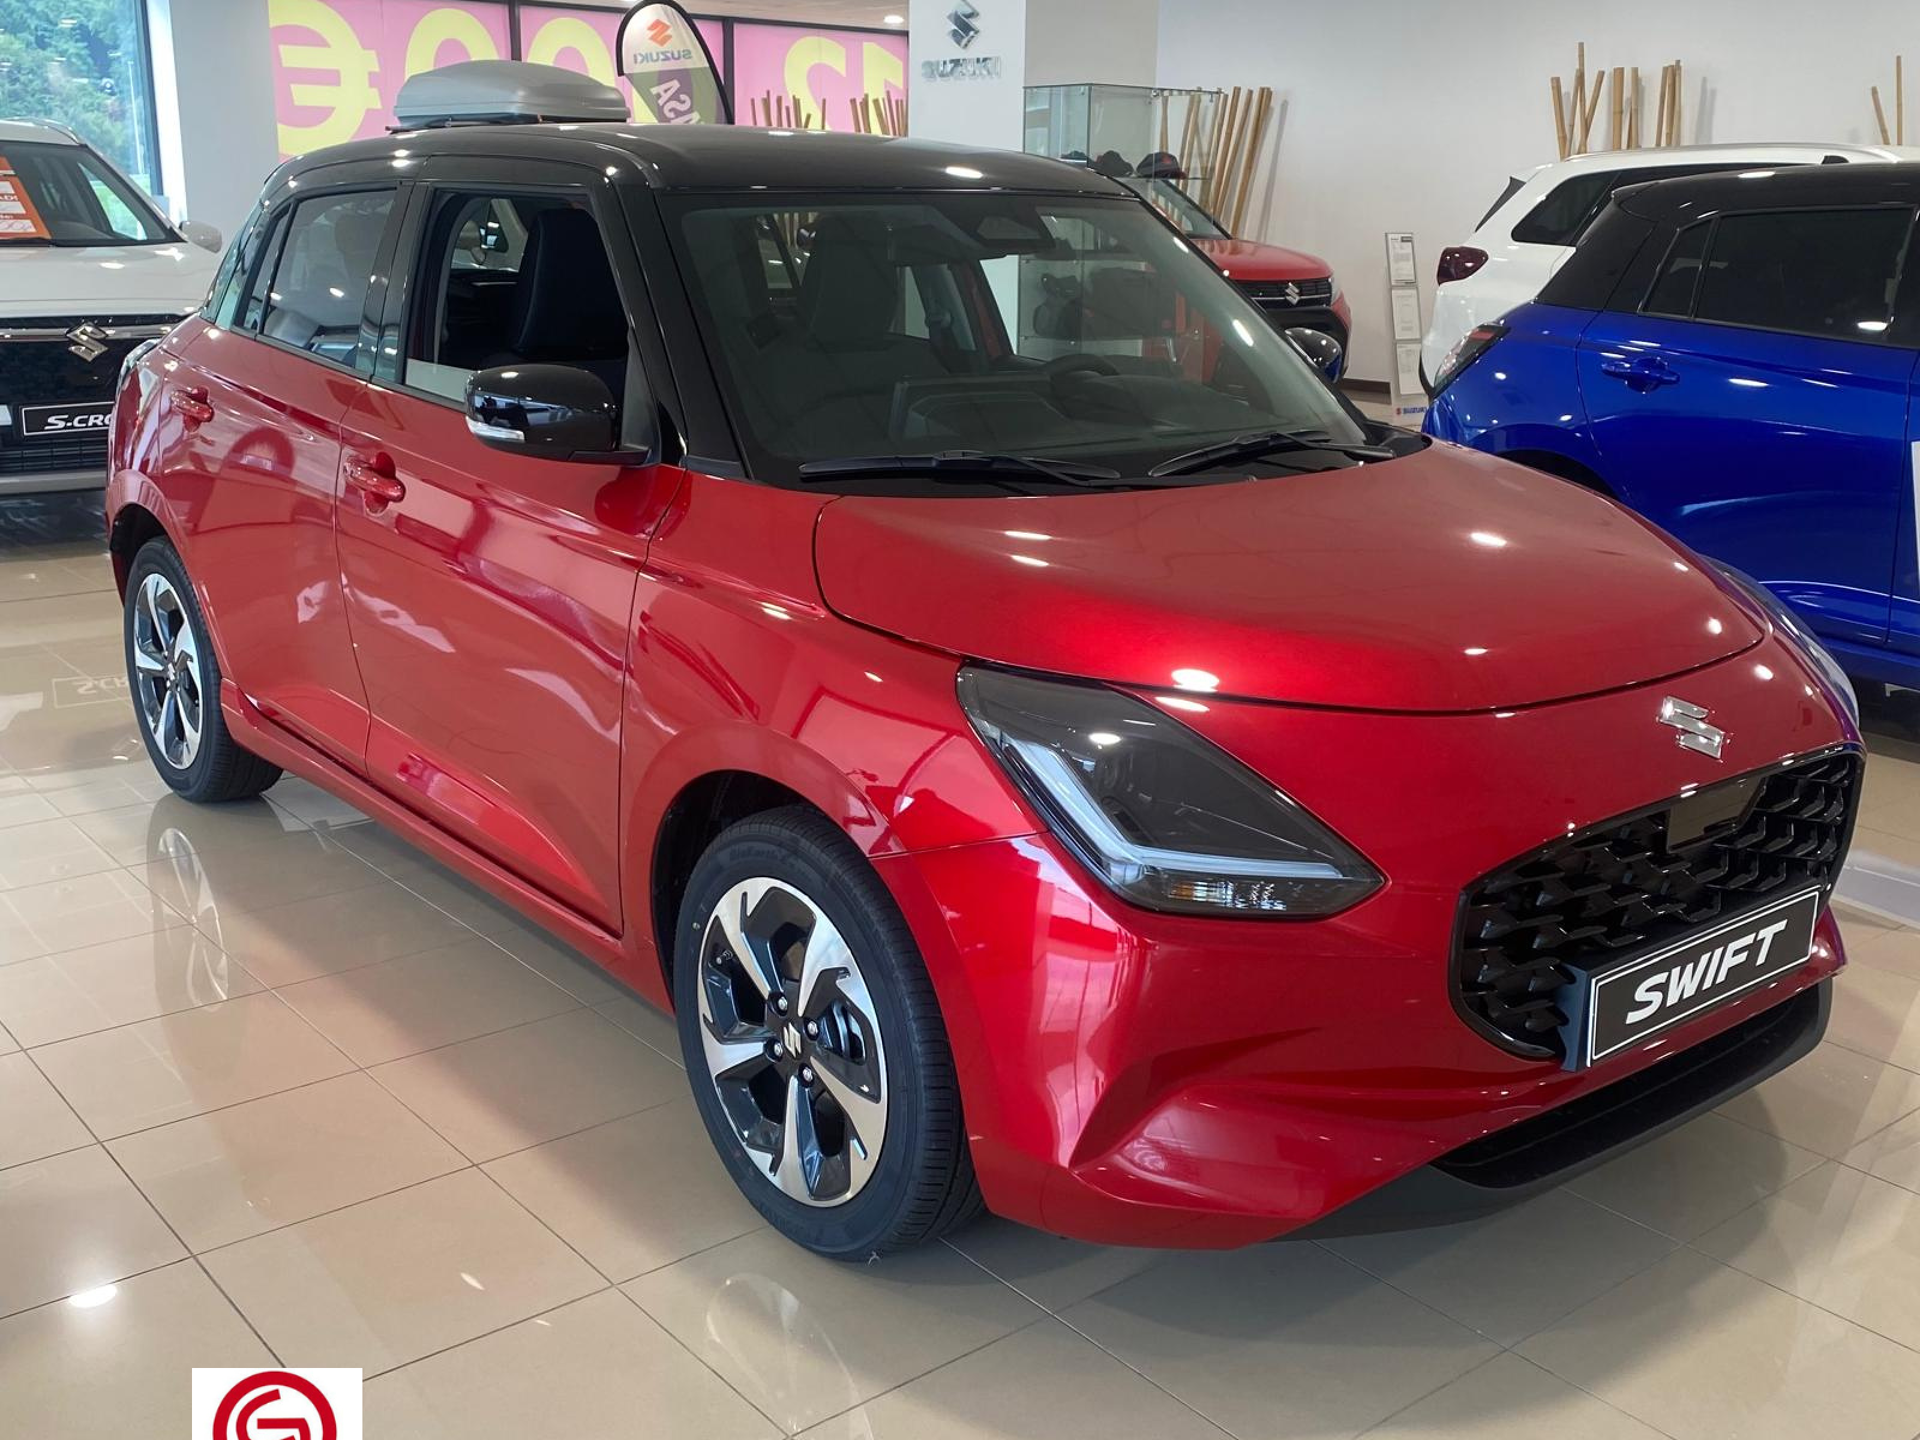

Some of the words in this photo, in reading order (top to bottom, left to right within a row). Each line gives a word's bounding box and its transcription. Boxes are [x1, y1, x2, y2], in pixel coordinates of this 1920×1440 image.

[921, 57, 1001, 79] SUZUKI
[1402, 406, 1427, 414] SUZUK
[1625, 919, 1788, 1025] SWIFT
